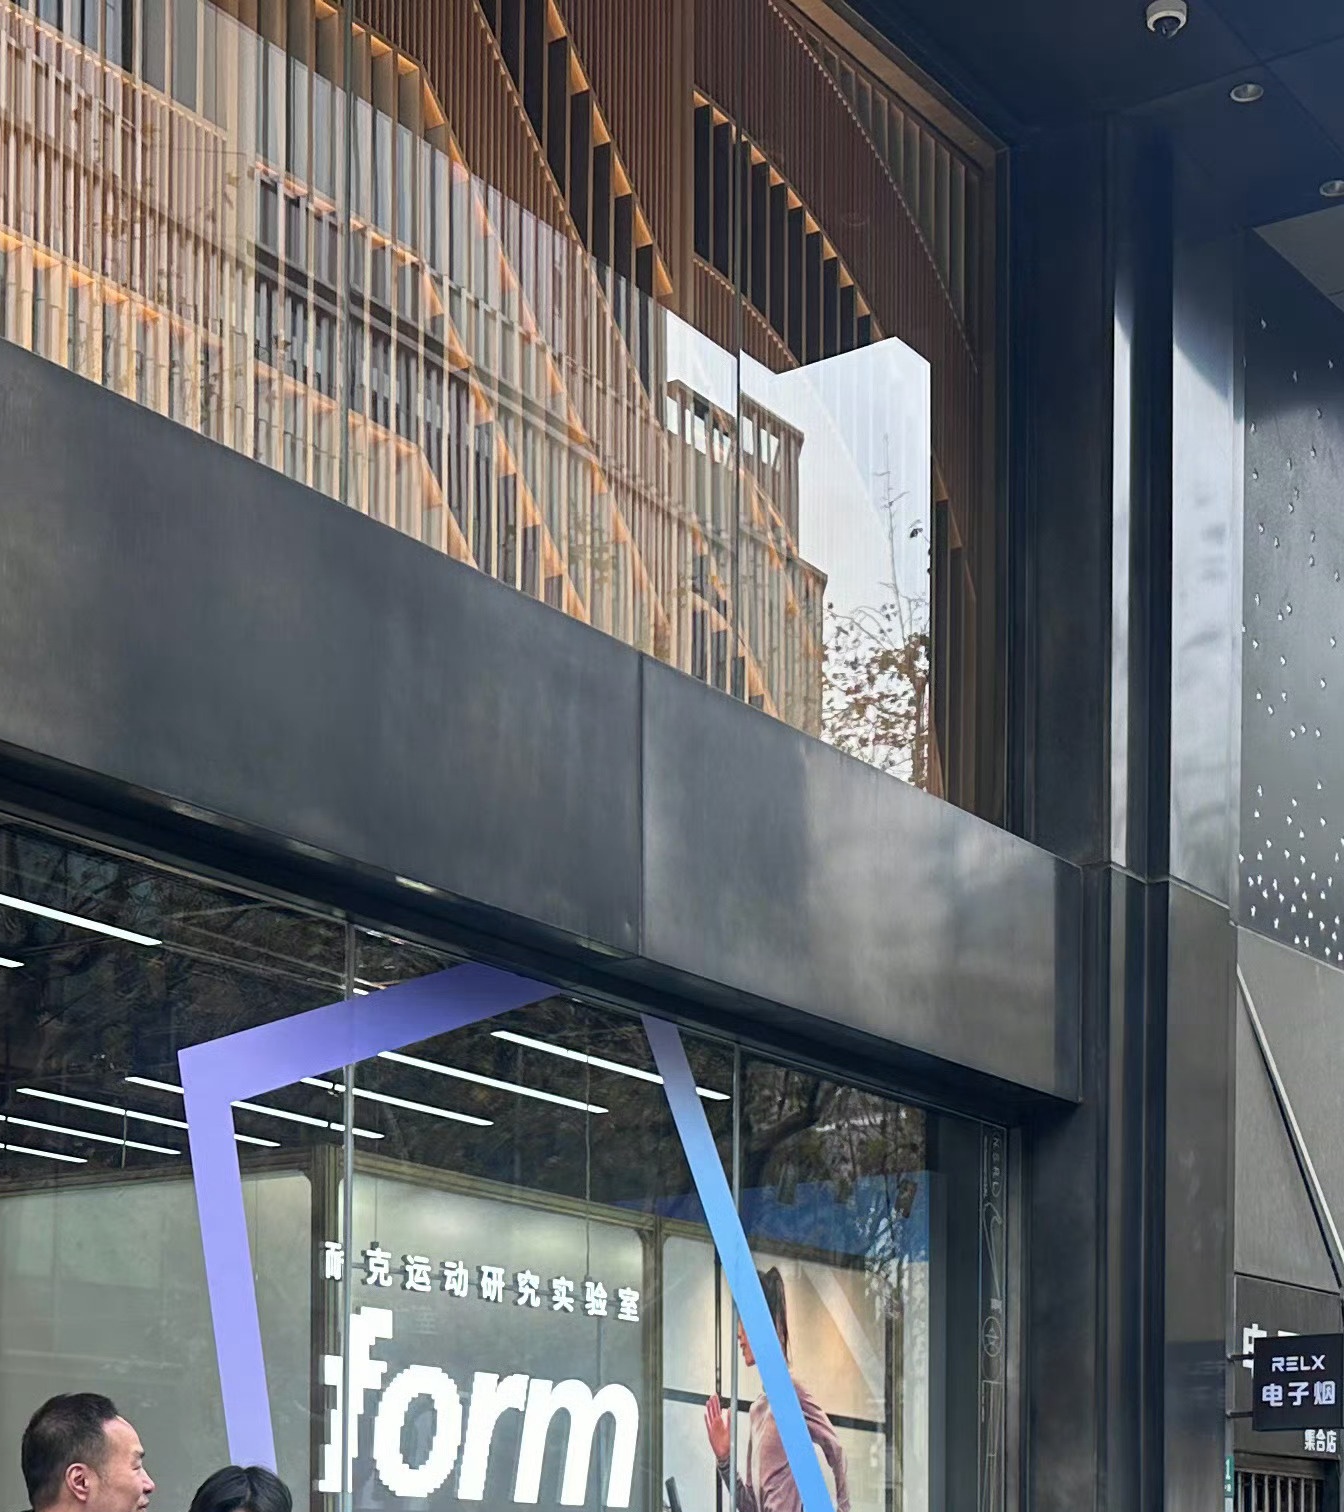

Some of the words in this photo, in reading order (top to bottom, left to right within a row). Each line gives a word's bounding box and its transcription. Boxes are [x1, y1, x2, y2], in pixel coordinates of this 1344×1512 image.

[1271, 1354, 1326, 1373] RELX
[1261, 1380, 1336, 1407] 电子烟
[1304, 1429, 1337, 1453] 集合店
